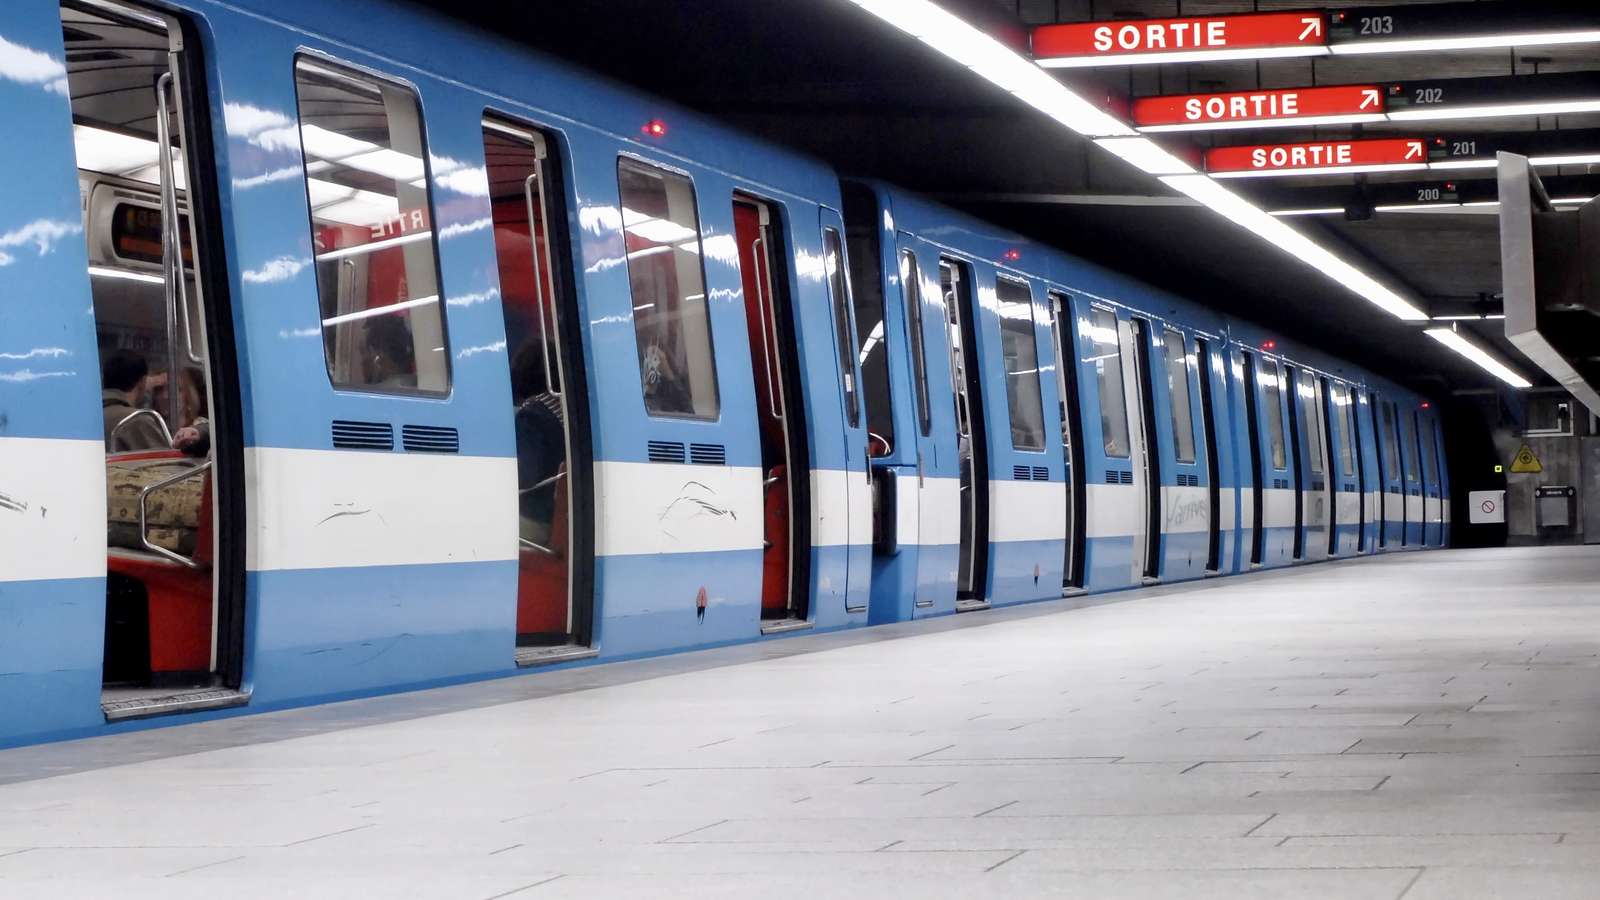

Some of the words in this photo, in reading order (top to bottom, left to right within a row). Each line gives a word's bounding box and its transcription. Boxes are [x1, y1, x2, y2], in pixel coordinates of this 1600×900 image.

[1360, 15, 1393, 35] 203
[1093, 21, 1227, 51] SORTIE
[1415, 88, 1443, 104] 202
[1185, 93, 1299, 120] SORTIE
[1251, 144, 1352, 168] SORTIE
[1453, 141, 1476, 156] 201
[1417, 188, 1440, 201] 200
